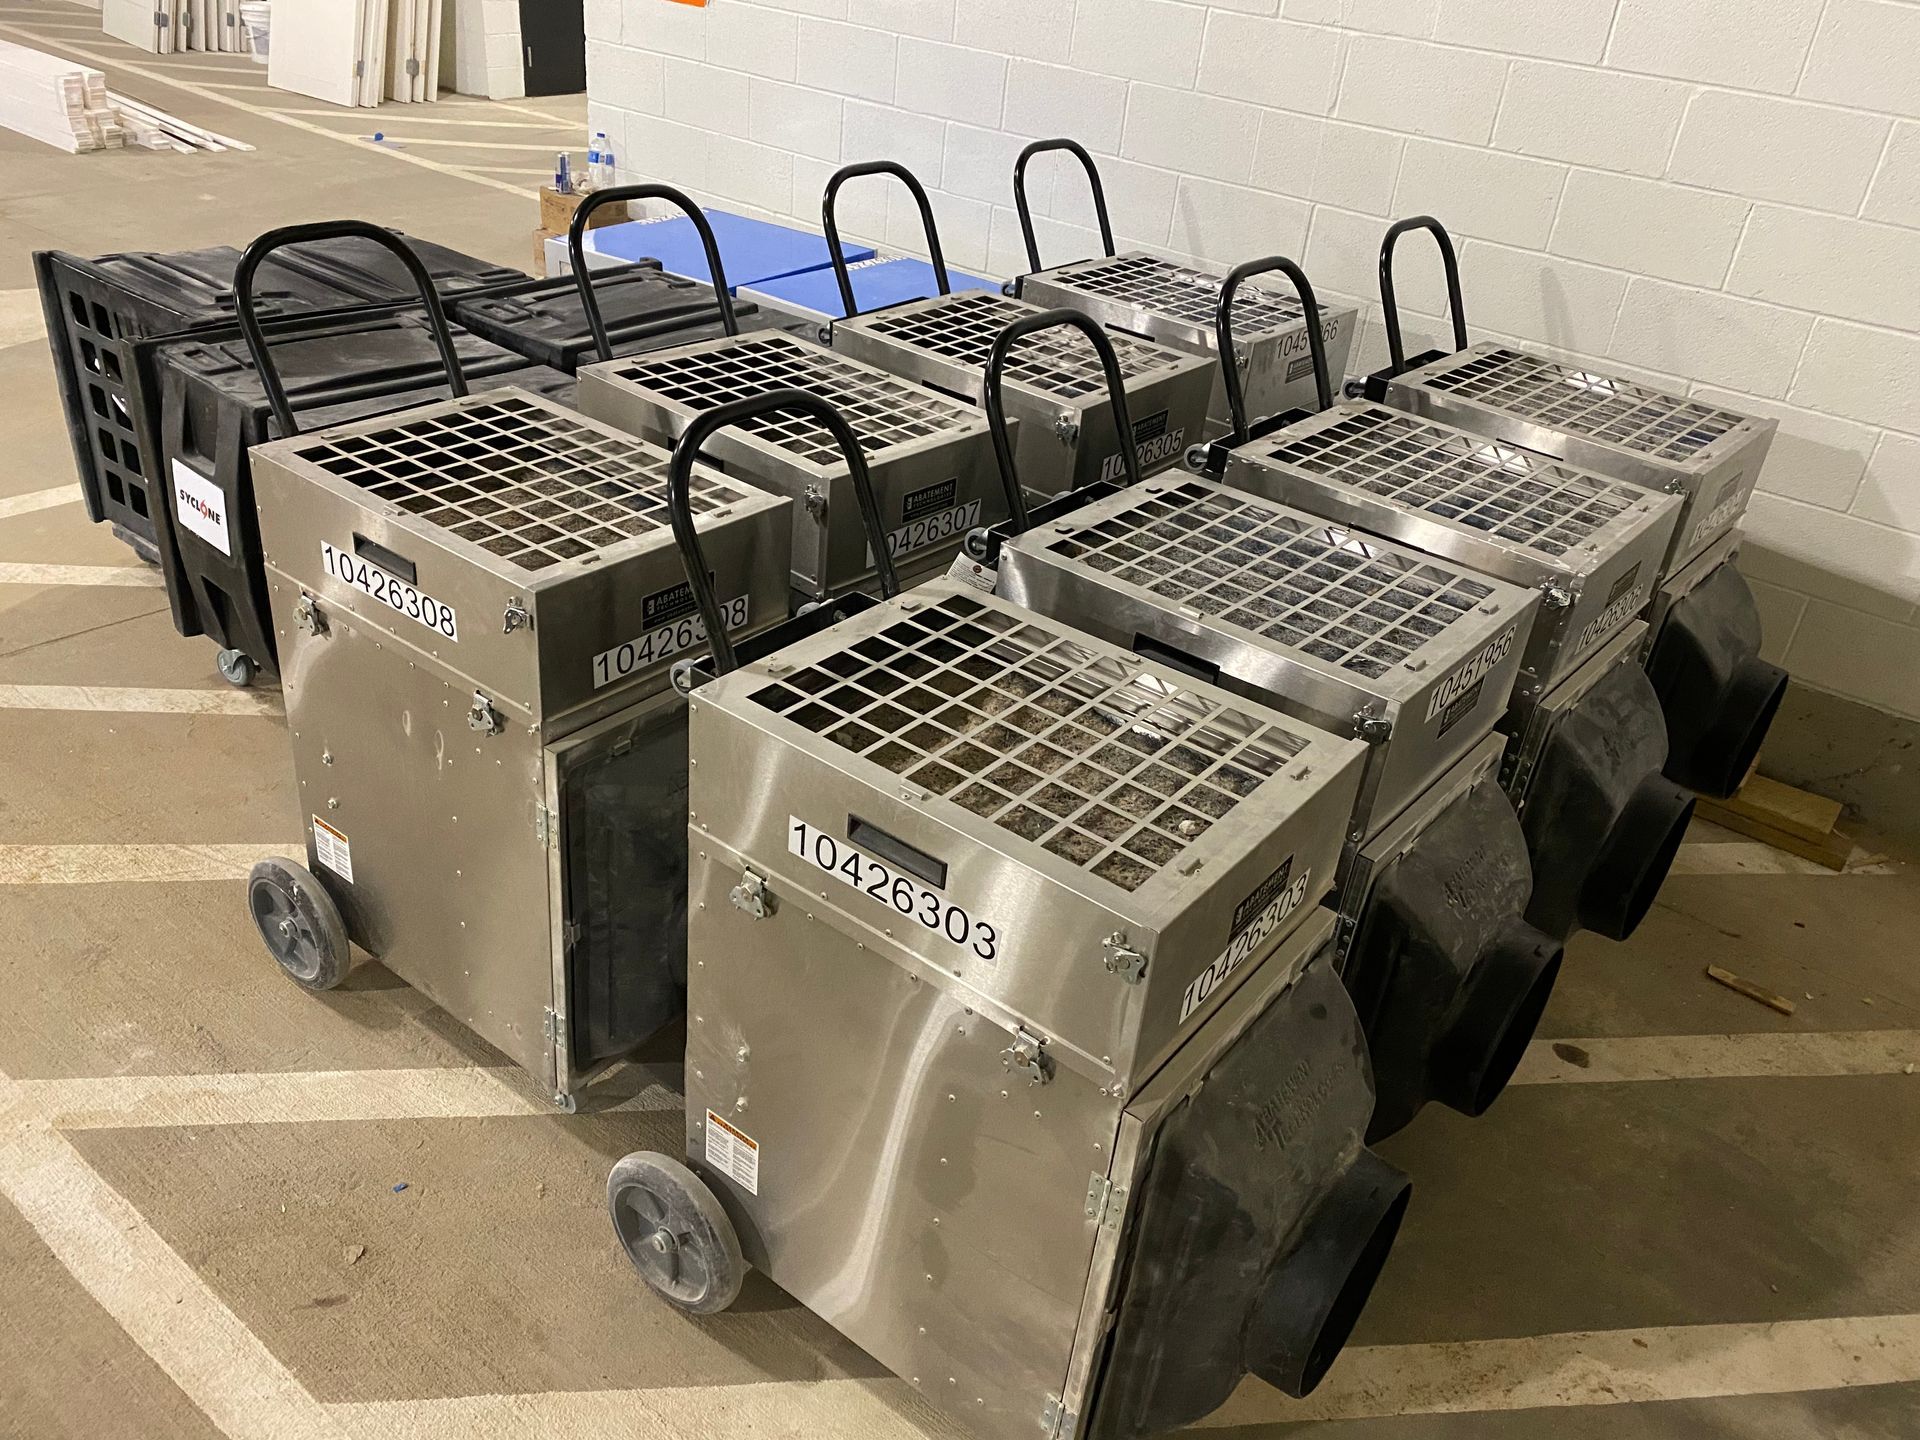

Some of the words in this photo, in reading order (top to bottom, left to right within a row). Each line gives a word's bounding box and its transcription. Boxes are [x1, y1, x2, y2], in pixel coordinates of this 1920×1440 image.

[1278, 319, 1339, 359] 104566
[1105, 429, 1183, 480] 1026305
[887, 500, 980, 556] 0426307
[325, 546, 455, 637] 10426308
[656, 586, 690, 606] ABATE
[1579, 585, 1643, 651] 10426306
[1431, 625, 1515, 717] 10451956
[794, 823, 996, 960] 10426303
[1185, 873, 1307, 1017] 10426303
